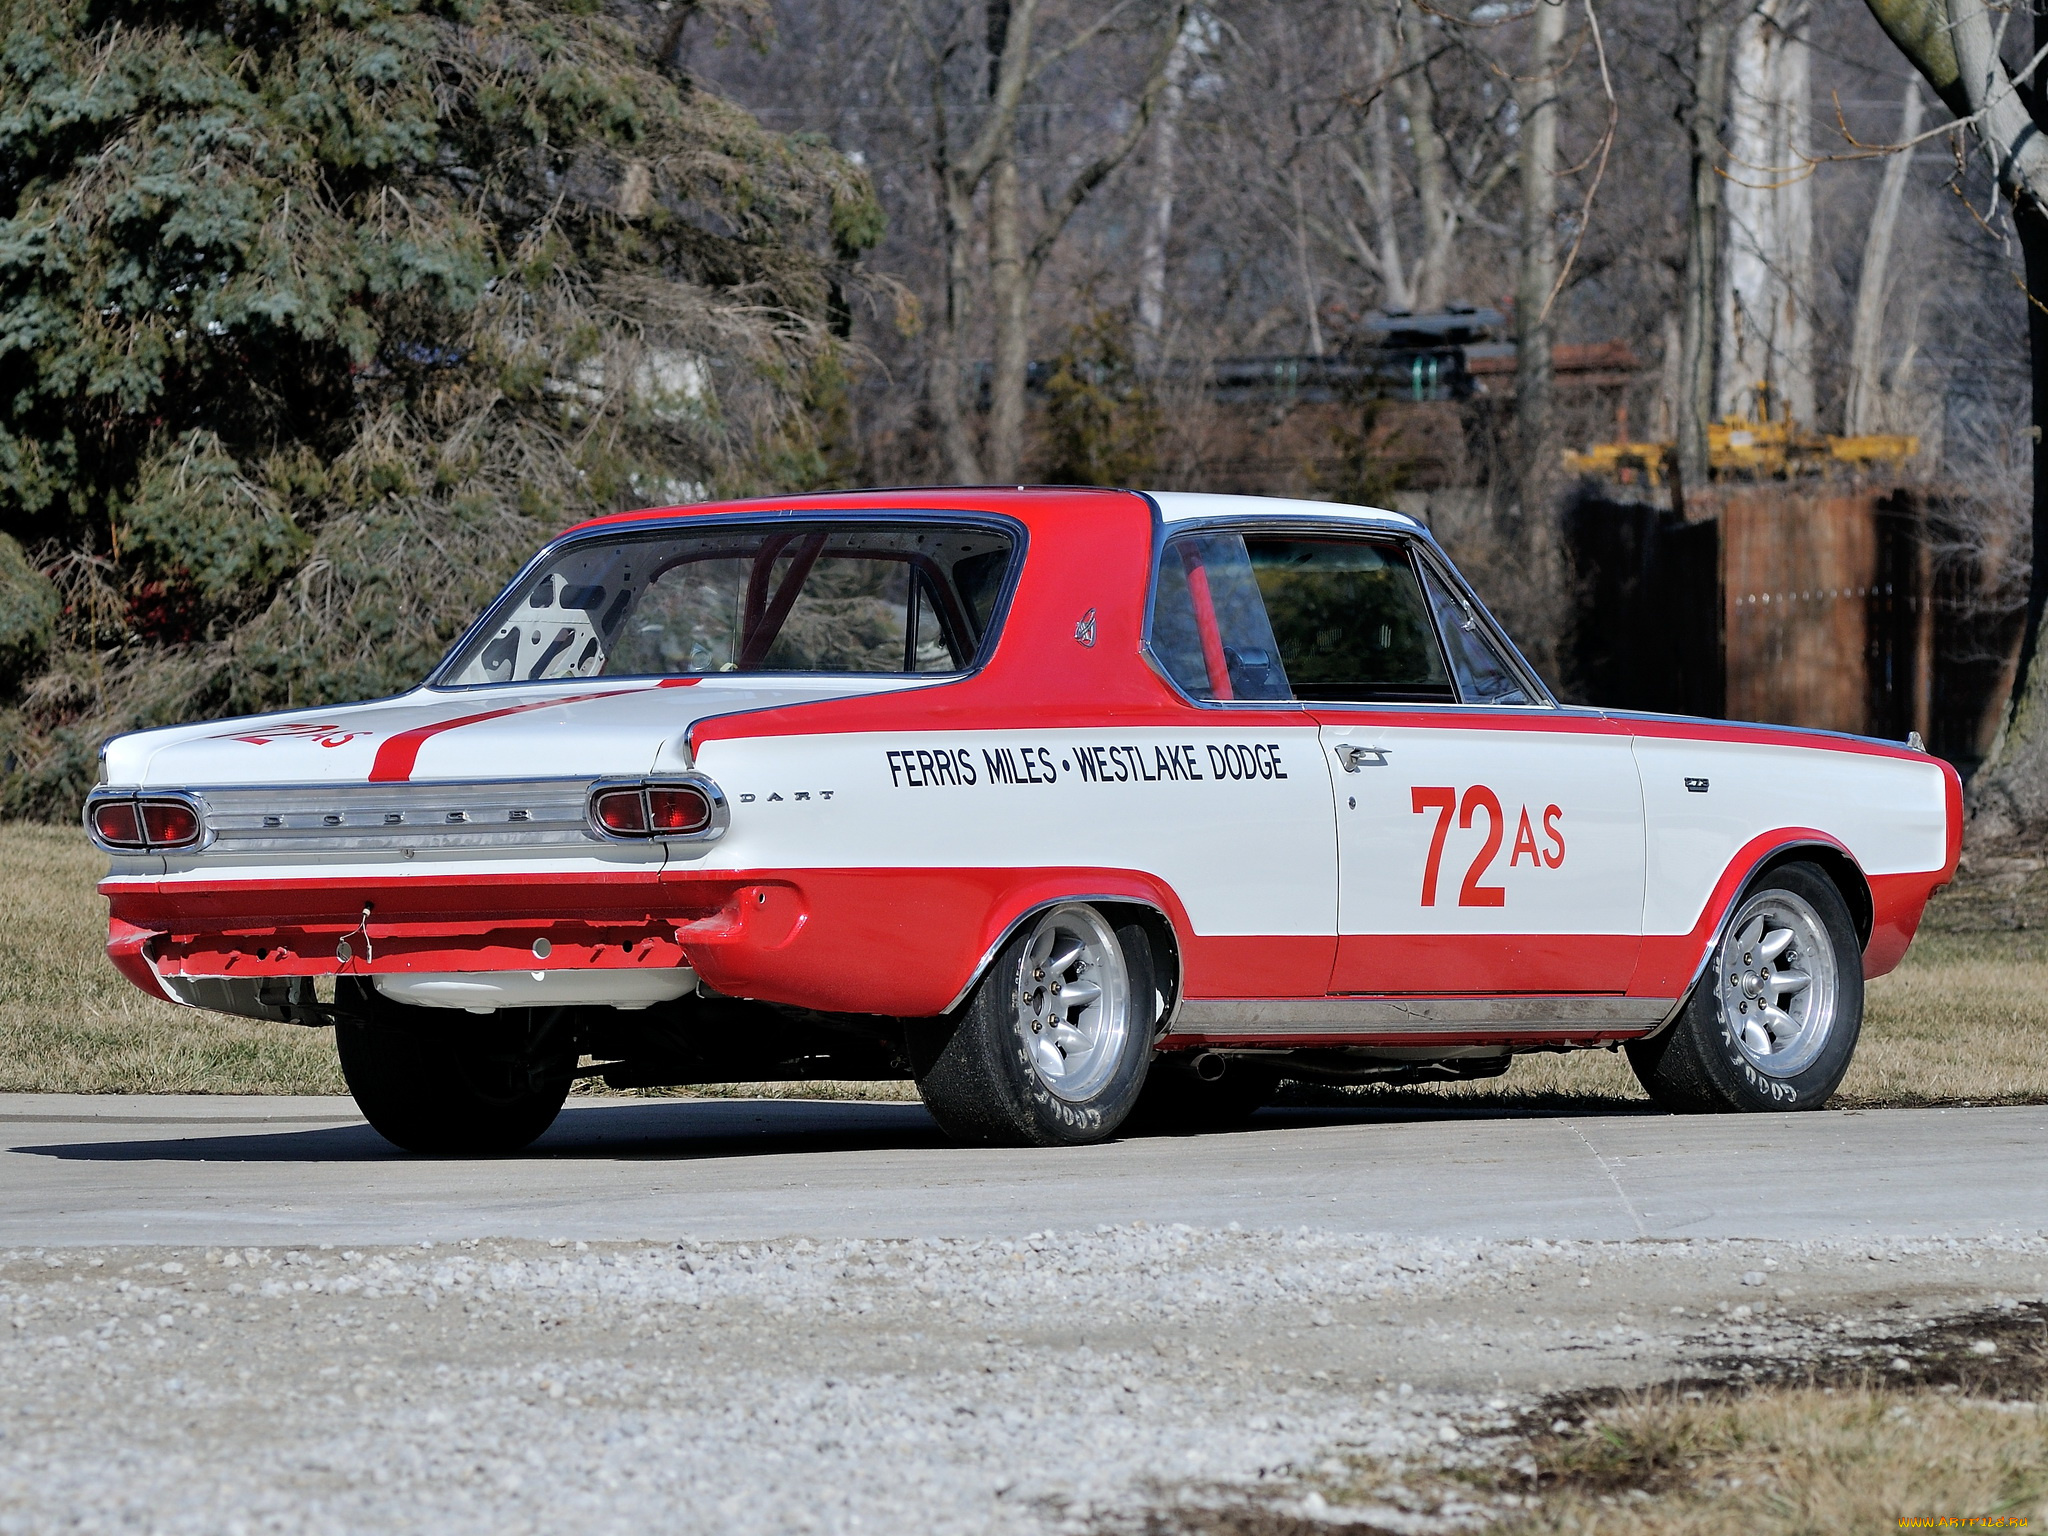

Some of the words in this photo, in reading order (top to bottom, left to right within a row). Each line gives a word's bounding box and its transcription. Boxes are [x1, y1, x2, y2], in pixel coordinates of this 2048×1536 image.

[885, 749, 977, 787] FERRIS
[982, 747, 1057, 785] MILES
[1072, 744, 1204, 783] WESTLAKE
[1207, 743, 1288, 780] DODGE
[740, 790, 835, 803] DART
[262, 808, 532, 829] DODGE
